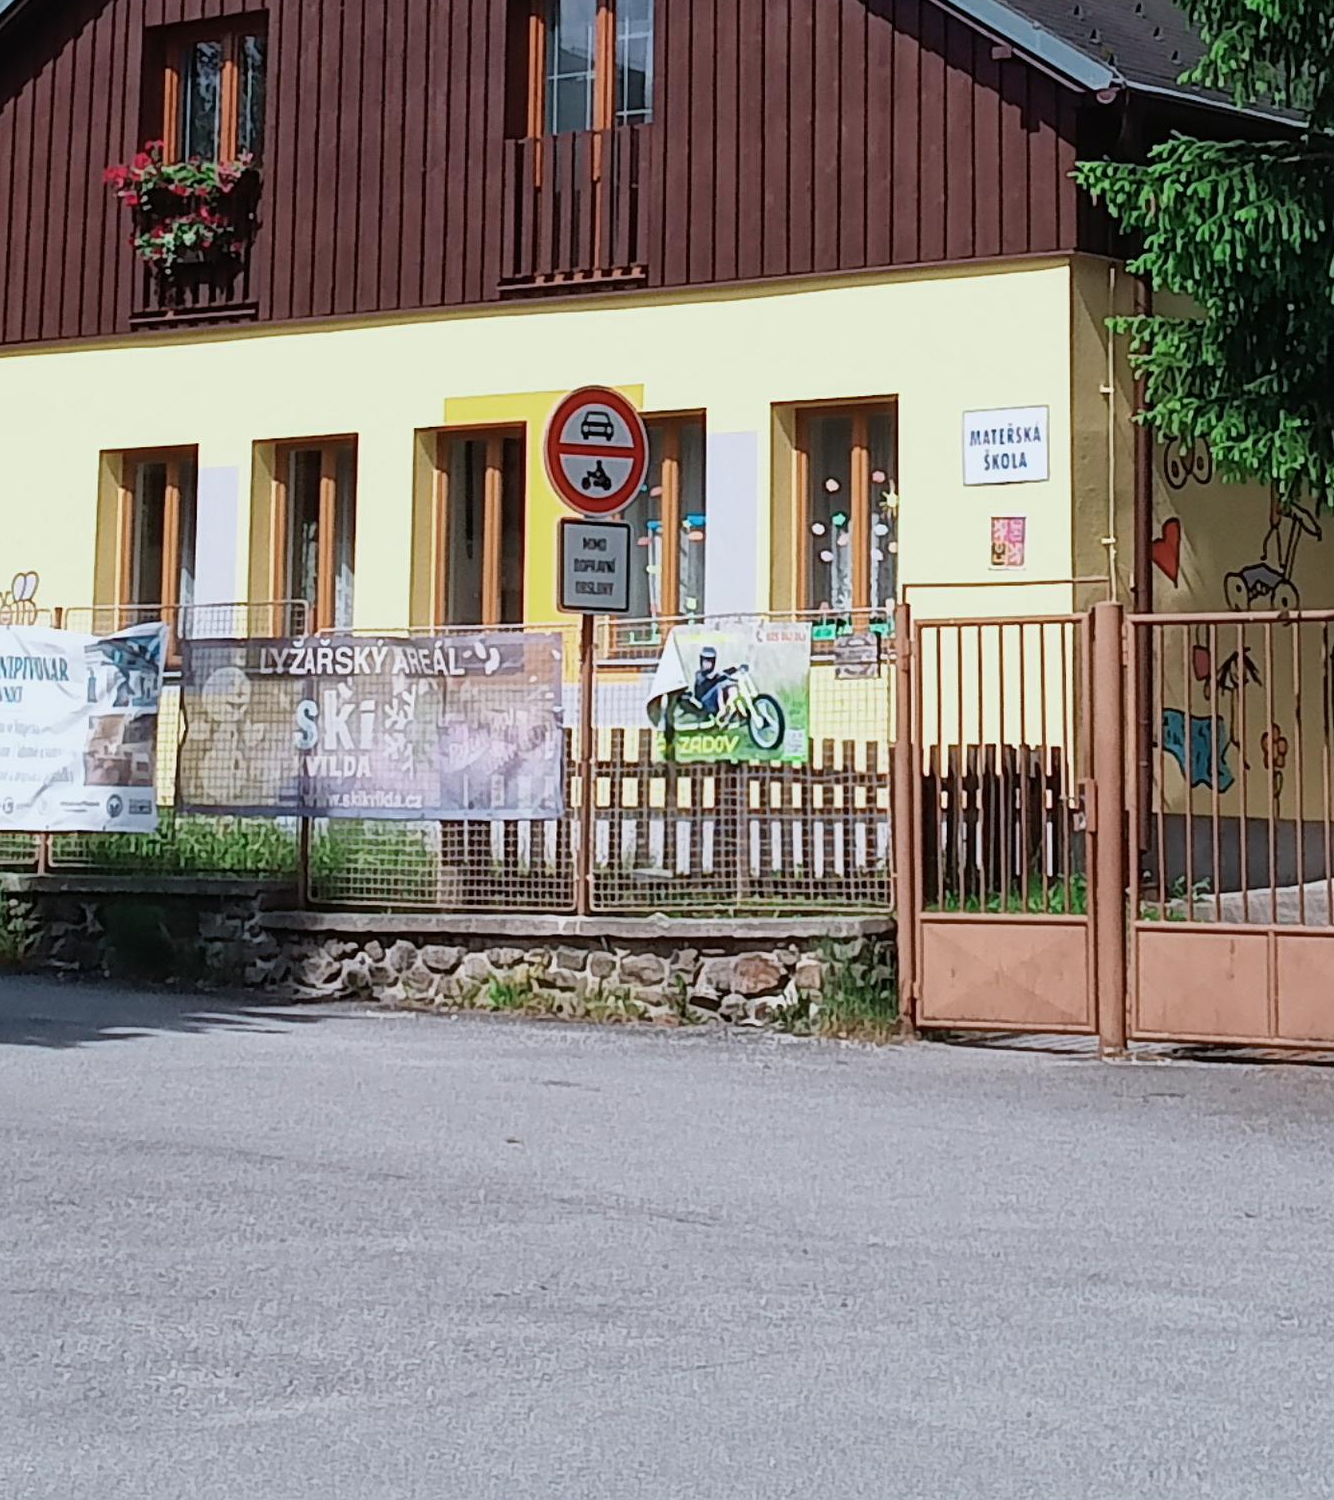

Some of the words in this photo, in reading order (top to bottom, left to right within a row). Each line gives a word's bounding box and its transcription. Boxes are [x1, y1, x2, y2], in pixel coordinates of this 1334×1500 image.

[970, 422, 1041, 447] MATEŘSKÁ
[983, 449, 1027, 471] ŠKOLA
[259, 638, 387, 675] LYŽAŘSKÝ
[392, 641, 466, 676] AREÁL
[679, 735, 740, 754] ZADOV
